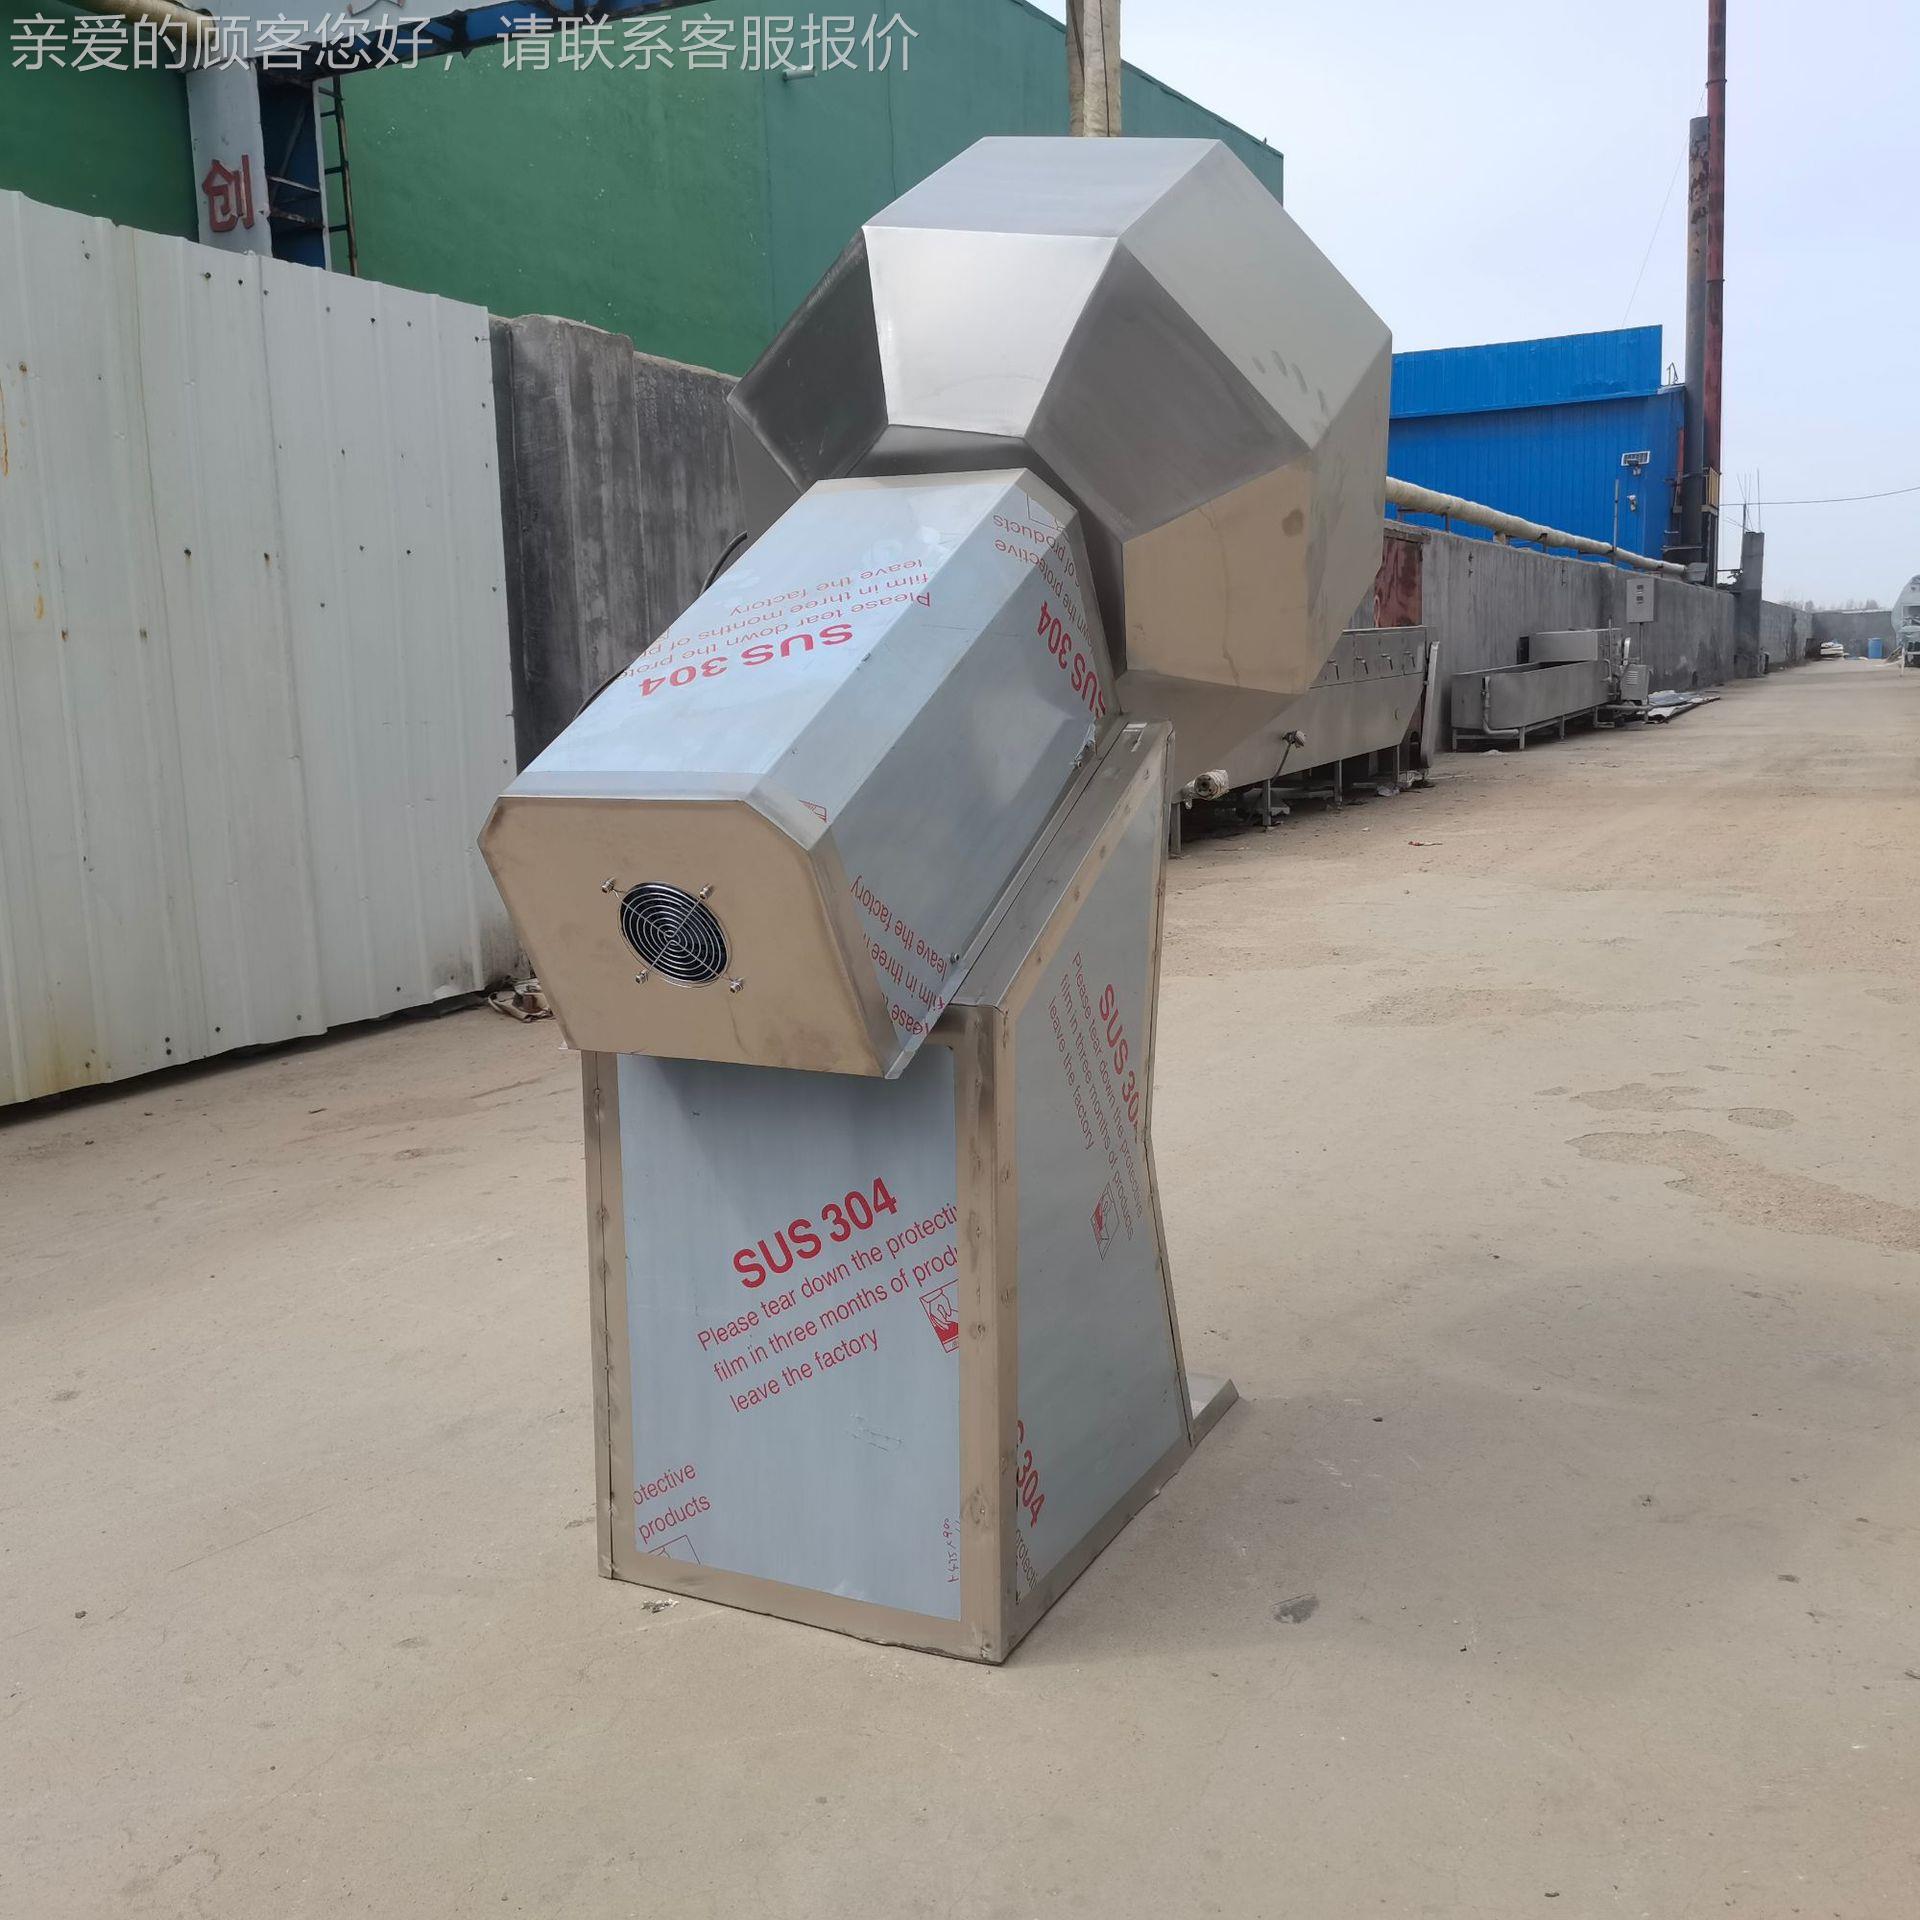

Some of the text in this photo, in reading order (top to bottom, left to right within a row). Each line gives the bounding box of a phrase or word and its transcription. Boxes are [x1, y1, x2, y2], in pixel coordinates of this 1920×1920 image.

[202, 154, 255, 233] 创
[993, 514, 1066, 559] products
[729, 560, 922, 619] leave the factory
[859, 585, 879, 597] in
[886, 571, 928, 589] film
[995, 539, 1063, 600] protective
[698, 608, 784, 640] months
[790, 591, 851, 615] three
[797, 609, 842, 629] tear
[851, 592, 930, 615] Please
[669, 636, 690, 650] of
[681, 643, 717, 661] the
[726, 623, 789, 647] down
[1037, 601, 1073, 669] 304
[639, 624, 853, 696] SUS 304
[850, 875, 893, 931] factory
[895, 920, 913, 951] the
[871, 943, 903, 983] three
[916, 940, 947, 981] leave
[906, 973, 918, 997] in
[919, 984, 944, 1011] film
[1099, 984, 1128, 1075] SUS
[1048, 996, 1095, 1151] leave the factory
[1072, 951, 1142, 1218] Please tear down the protective
[1060, 974, 1133, 1241] film in three months of products
[733, 1176, 898, 1289] SUS 304
[697, 1202, 957, 1351] Please tear down the protecti
[713, 1245, 957, 1382] film in three months of prod
[729, 1327, 879, 1413] leave the factory
[638, 1495, 711, 1544] products
